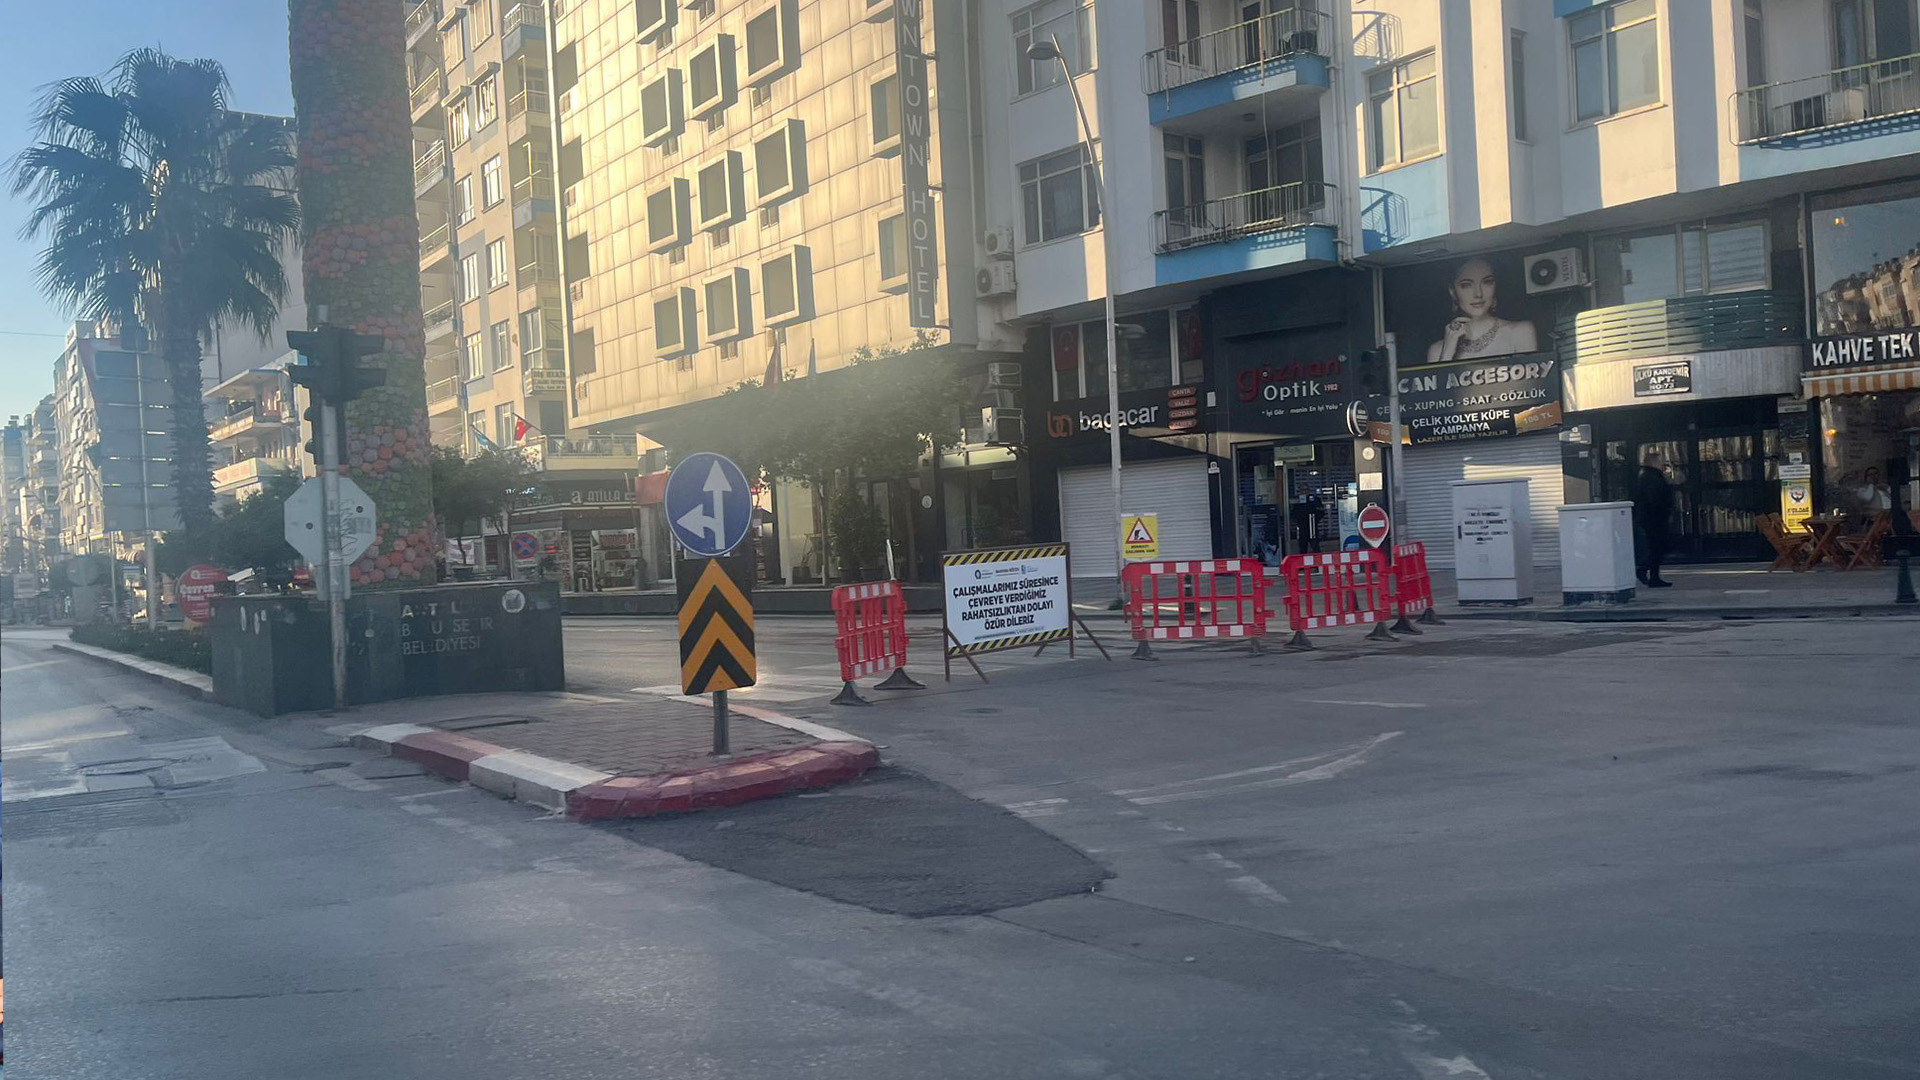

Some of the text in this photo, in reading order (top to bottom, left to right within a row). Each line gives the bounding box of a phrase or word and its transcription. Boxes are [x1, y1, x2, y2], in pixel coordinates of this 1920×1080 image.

[911, 190, 930, 319] HOTEL
[1812, 332, 1915, 367] KAHVE TEK
[1445, 360, 1555, 390] ACCESORY
[1649, 375, 1675, 384] APT.
[1263, 380, 1339, 401] Optik 1982
[1462, 395, 1491, 407] SAAT
[1499, 387, 1547, 402] GÖZLÜK
[1412, 408, 1511, 429] ÇELİK KOLYE KÜPE
[1523, 411, 1554, 425] 100 TL
[1432, 422, 1491, 436] KAMPANYA
[1477, 428, 1509, 439] YAZILIR
[952, 575, 1059, 599] ÇALIŞMALARIMIZ SÜRESİNCE
[967, 588, 1047, 609] ÇEVREYE VERDİĞİMİZ
[961, 600, 1054, 621] RAHATSIZLIKTAN DOLAYI
[984, 614, 1035, 630] ÖZÜR DİLERİZ
